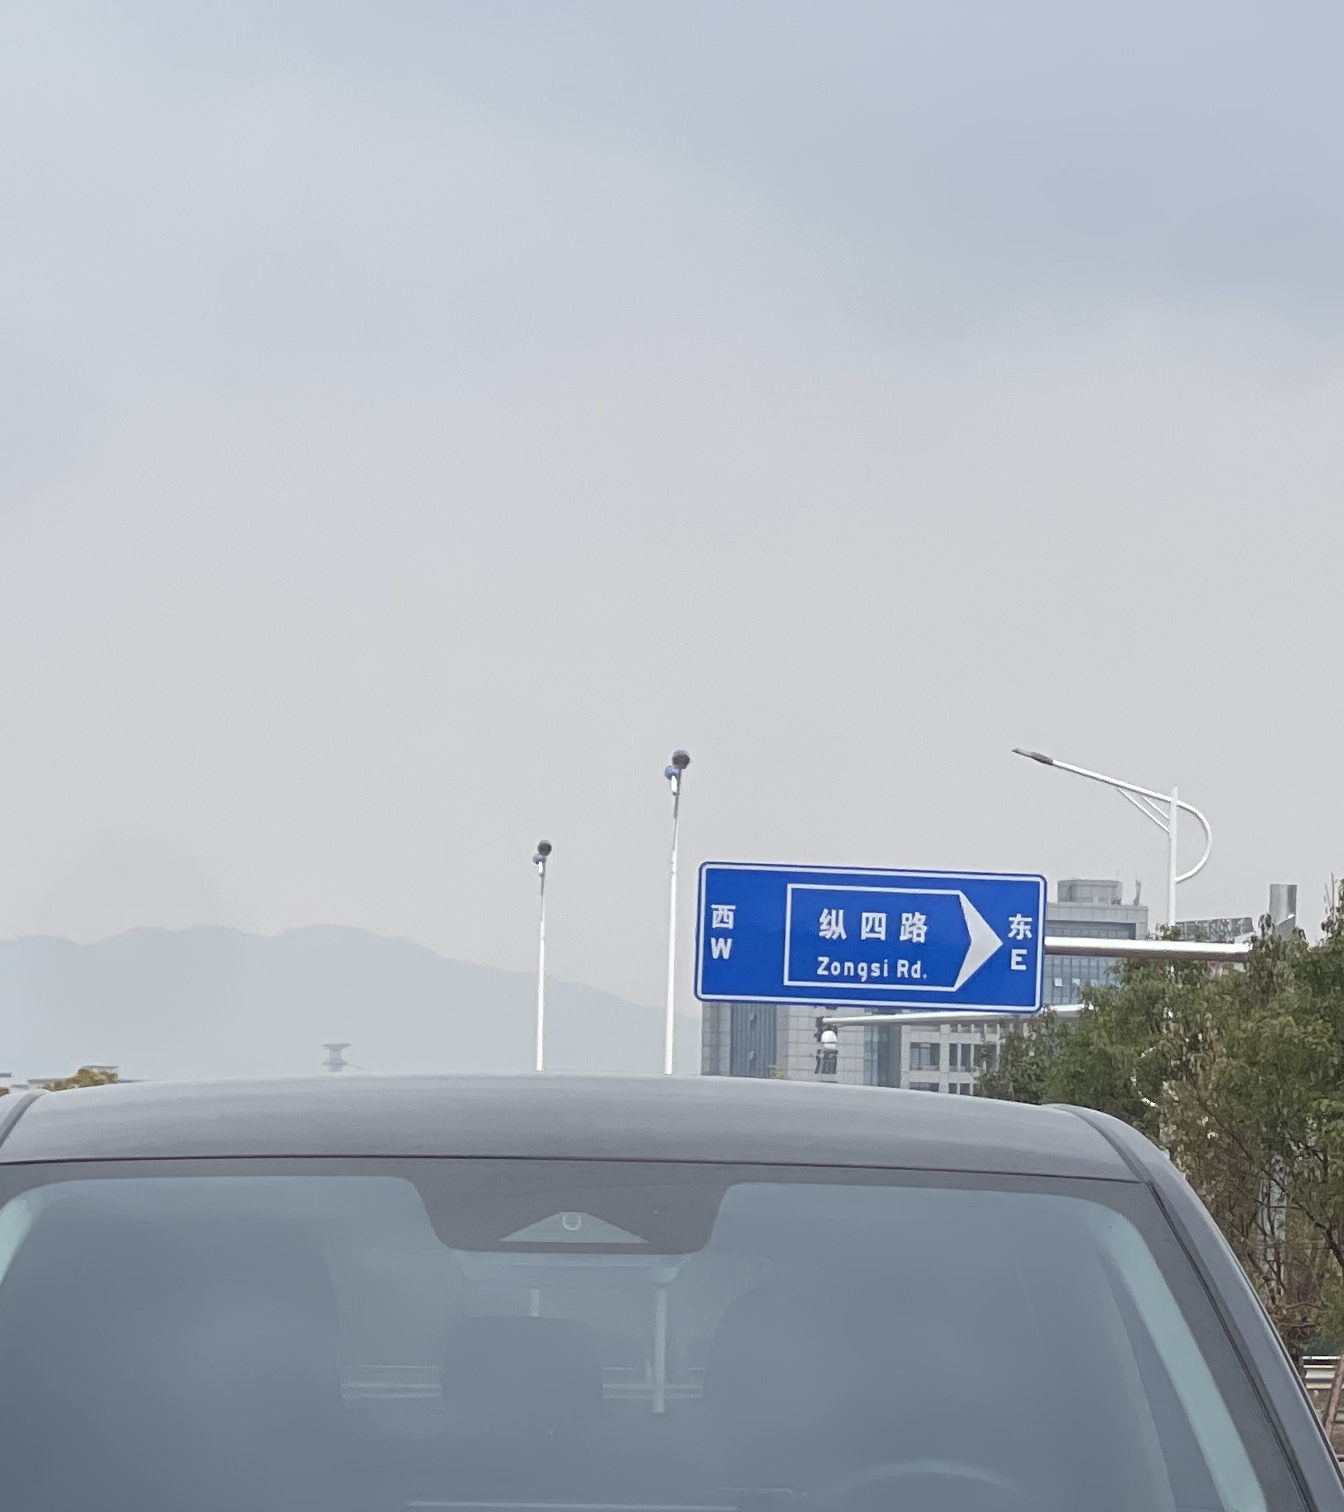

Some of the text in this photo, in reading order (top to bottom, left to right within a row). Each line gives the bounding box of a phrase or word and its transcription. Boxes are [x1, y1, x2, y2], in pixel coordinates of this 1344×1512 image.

[711, 904, 736, 929] 西
[819, 908, 925, 943] 纵四路
[1008, 914, 1032, 940] 东
[711, 937, 733, 959] W
[1011, 949, 1027, 970] E
[816, 957, 927, 982] Zongsi Rd.
